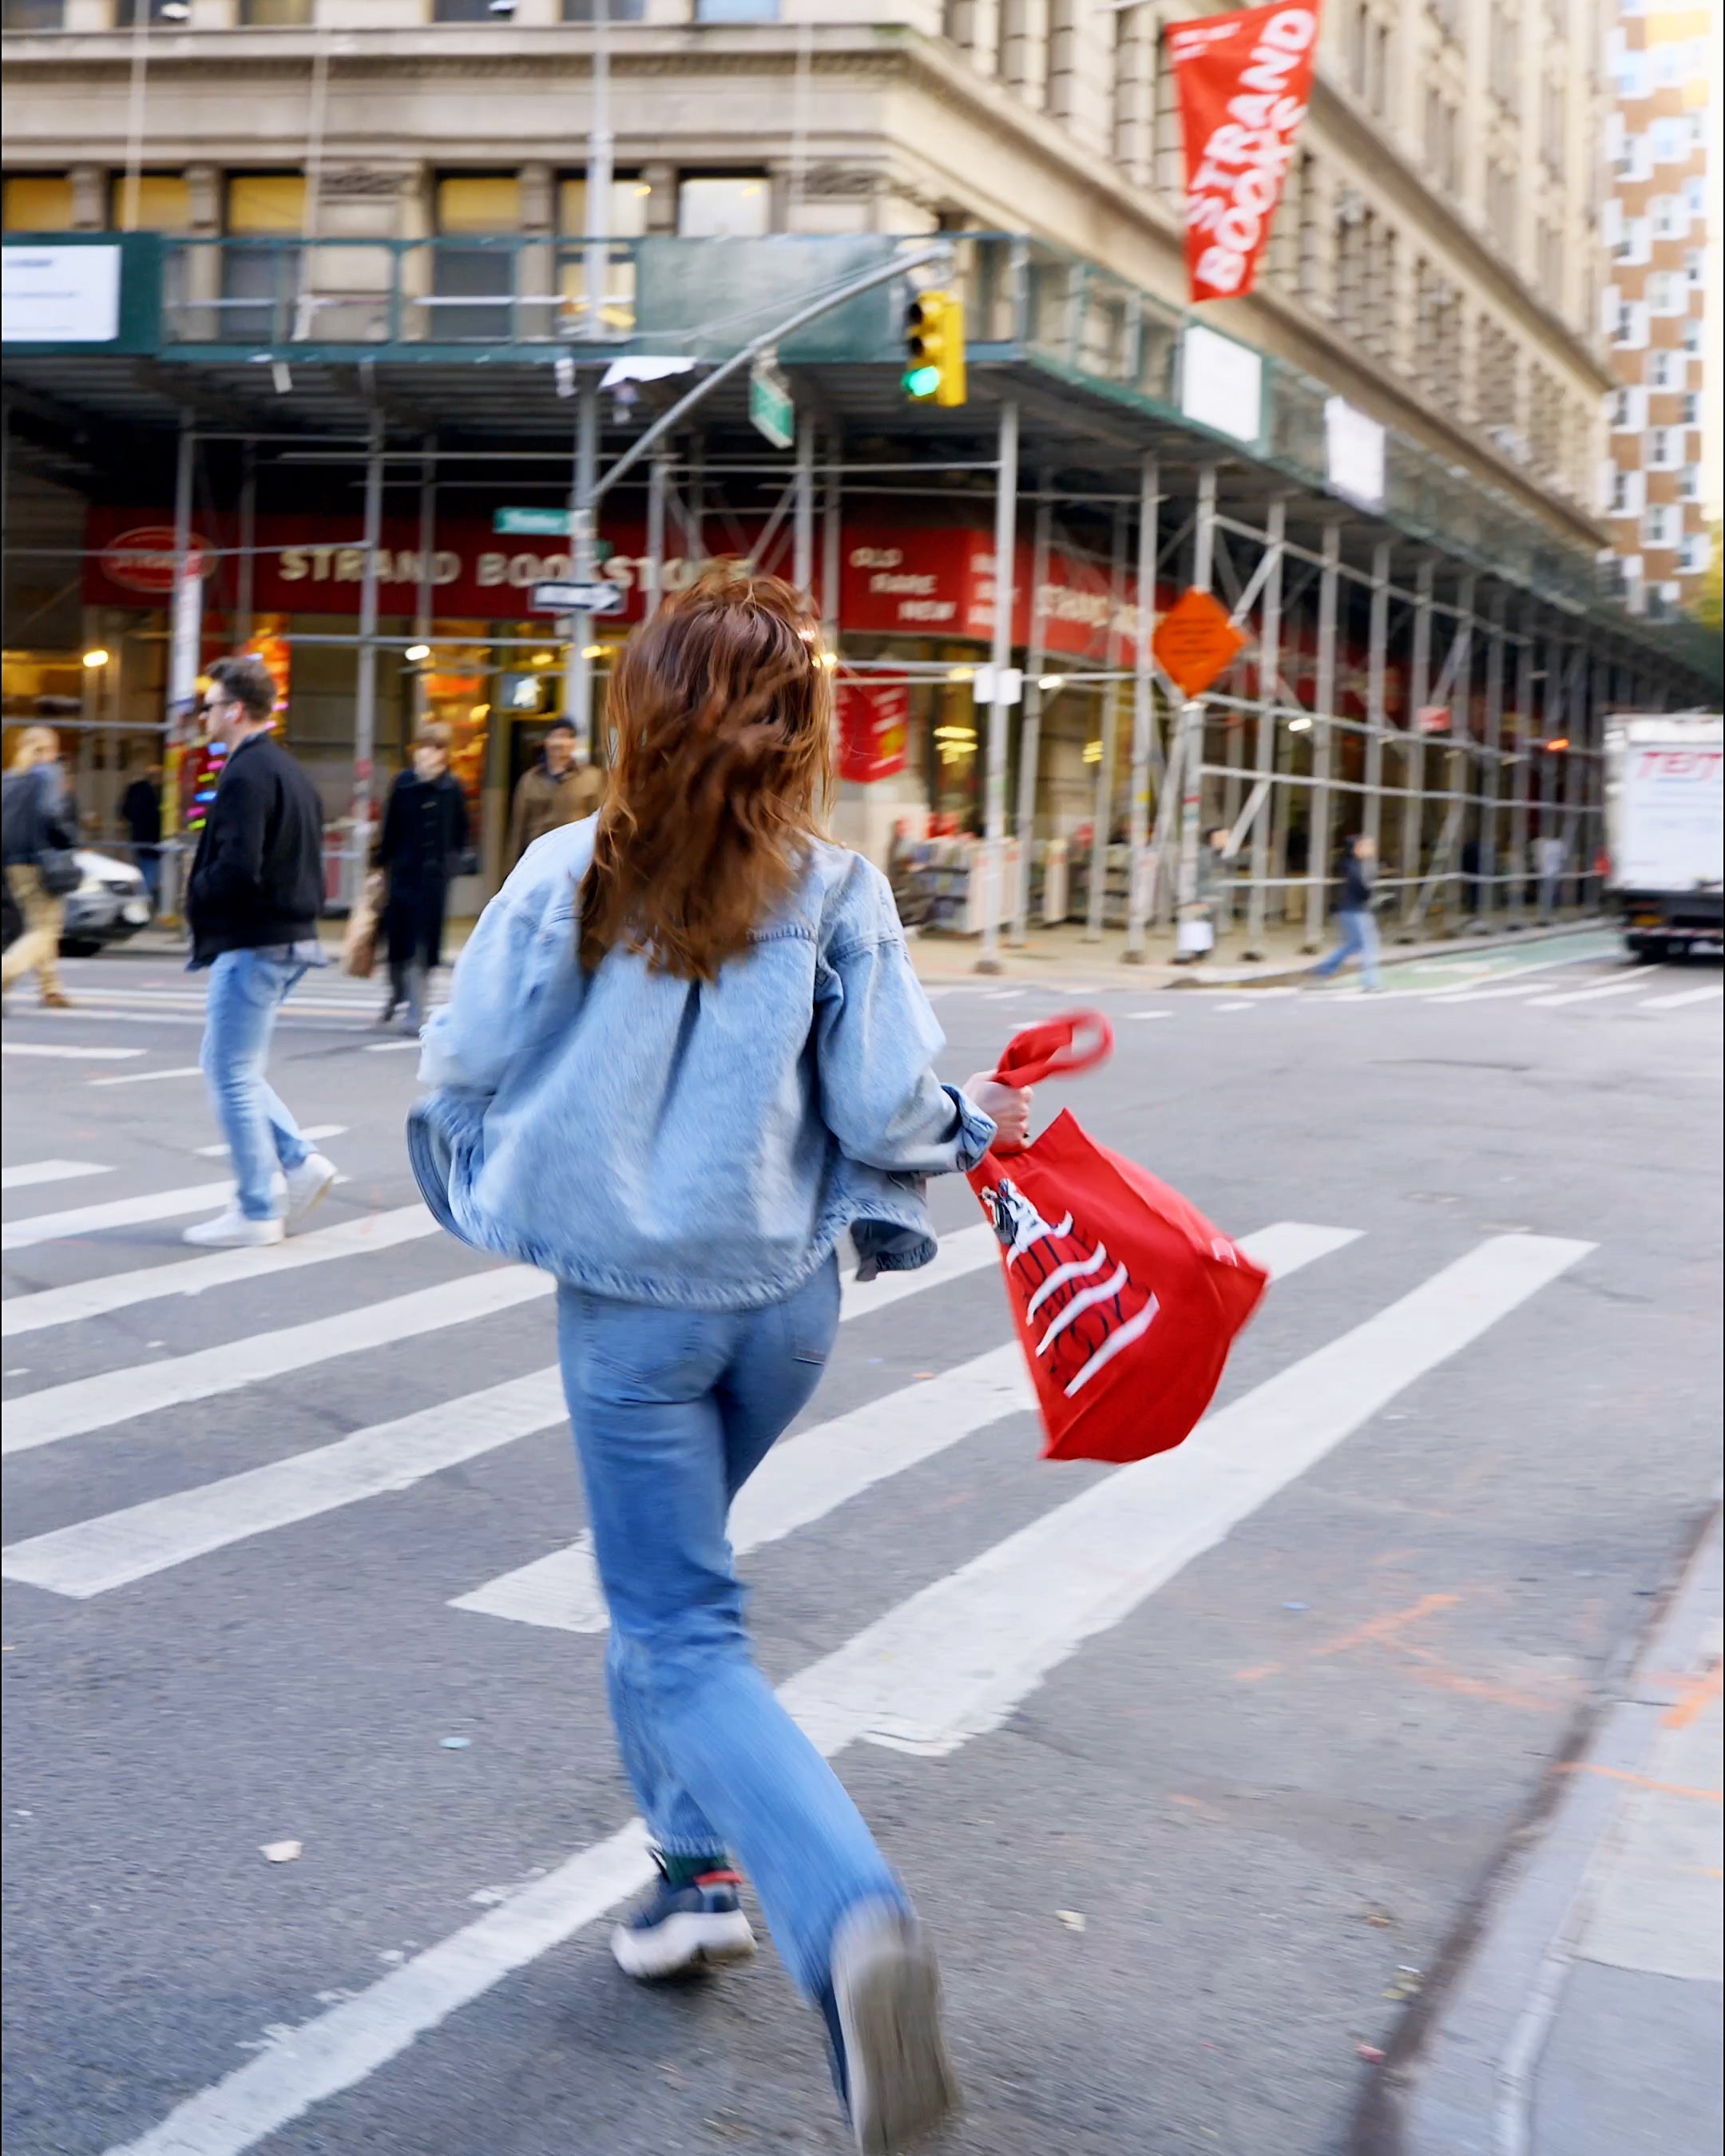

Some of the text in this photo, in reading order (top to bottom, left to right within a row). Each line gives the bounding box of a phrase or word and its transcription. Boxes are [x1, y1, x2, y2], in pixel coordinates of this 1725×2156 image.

[1184, 8, 1316, 232] STRAND
[1195, 94, 1308, 292] BOOKS
[279, 548, 462, 585] STRAND
